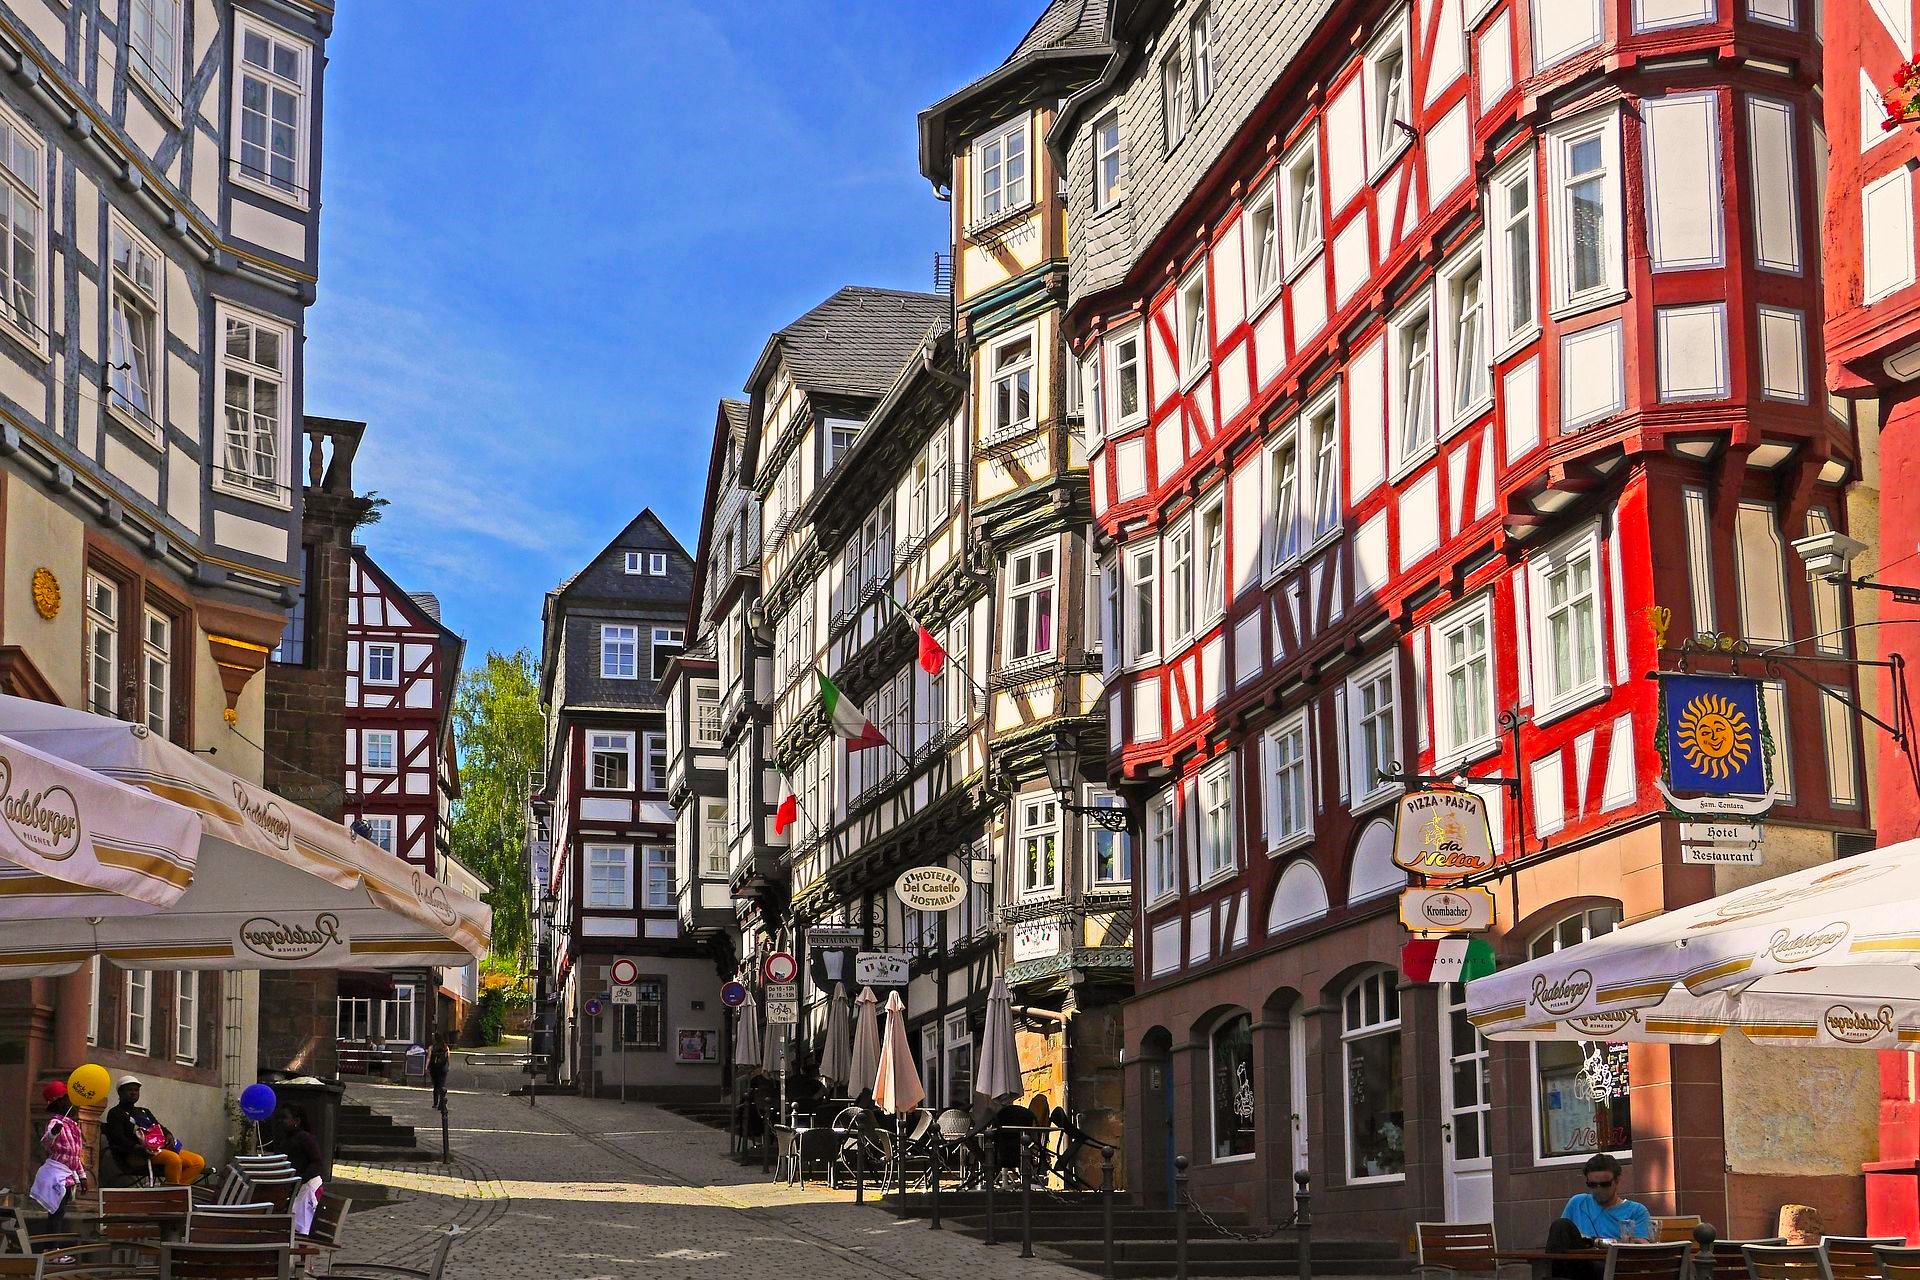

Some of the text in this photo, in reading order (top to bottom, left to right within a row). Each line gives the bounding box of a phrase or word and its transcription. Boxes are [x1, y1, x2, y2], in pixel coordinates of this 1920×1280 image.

[1407, 795, 1476, 815] PIZZA PASTA
[1707, 827, 1738, 839] Hotel
[23, 832, 51, 847] PILSNER
[1440, 841, 1463, 851] da
[1692, 850, 1754, 862] Restaurant
[914, 871, 948, 882] HOTEL
[903, 883, 960, 892] Del Castello
[910, 894, 956, 905] HOSTARIA
[1426, 905, 1468, 916] Krombacher
[1761, 924, 1850, 960] Radeberger
[1530, 971, 1591, 1008] Radeberger
[1564, 1124, 1628, 1150] Nea
